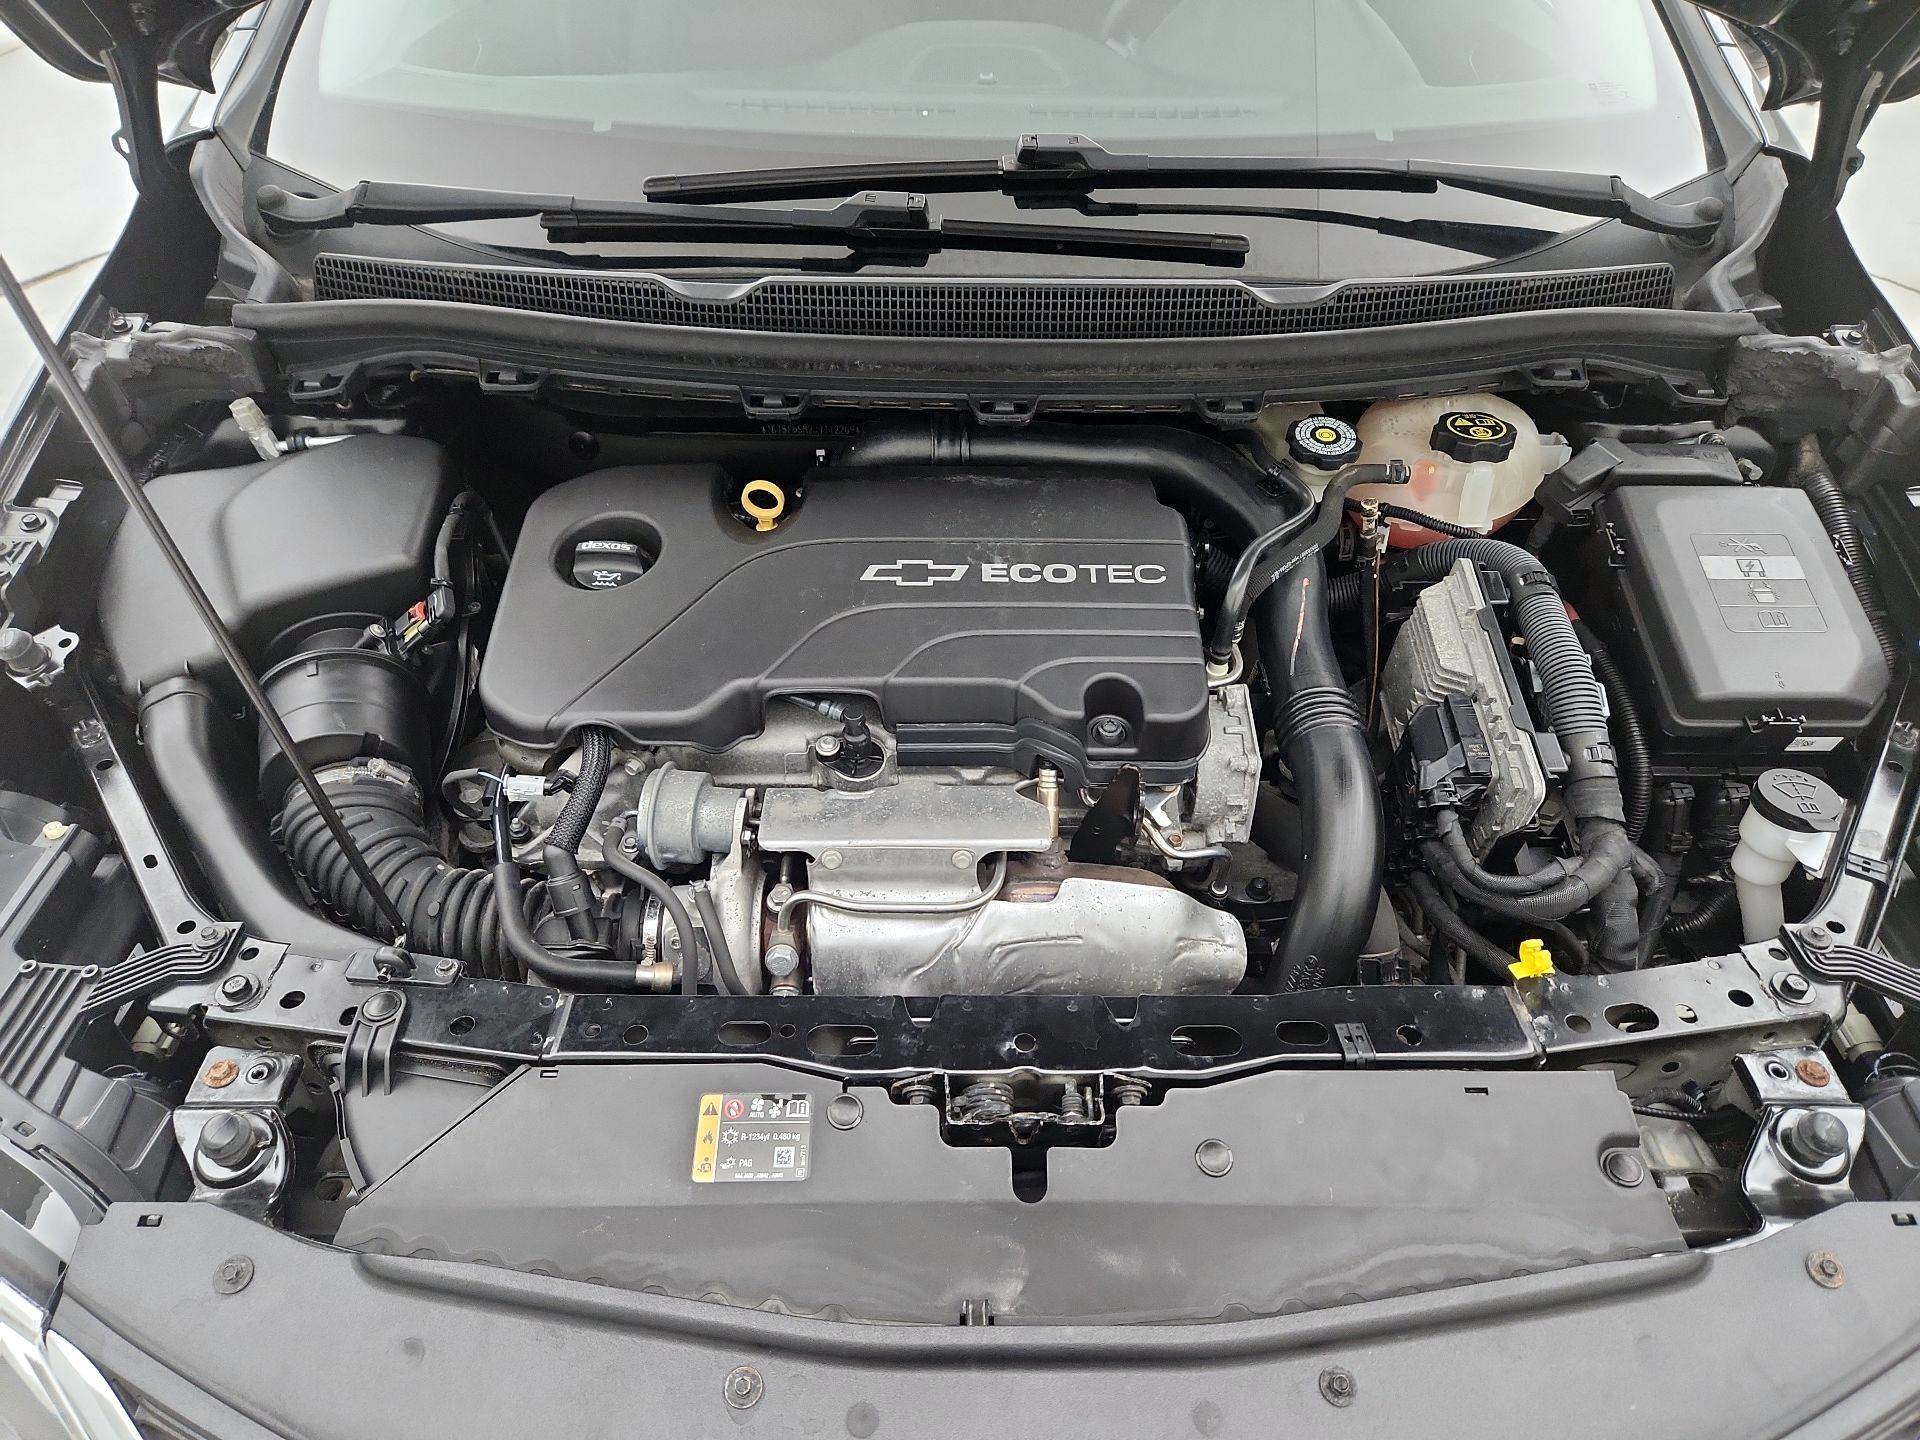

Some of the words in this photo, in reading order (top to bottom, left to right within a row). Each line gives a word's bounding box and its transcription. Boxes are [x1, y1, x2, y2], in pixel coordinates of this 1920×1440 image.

[581, 540, 633, 551] dexos
[981, 562, 1167, 584] ECOTEC
[740, 1132, 770, 1142] R-1234yf
[791, 1132, 801, 1142] kg
[738, 1158, 753, 1168] PAG
